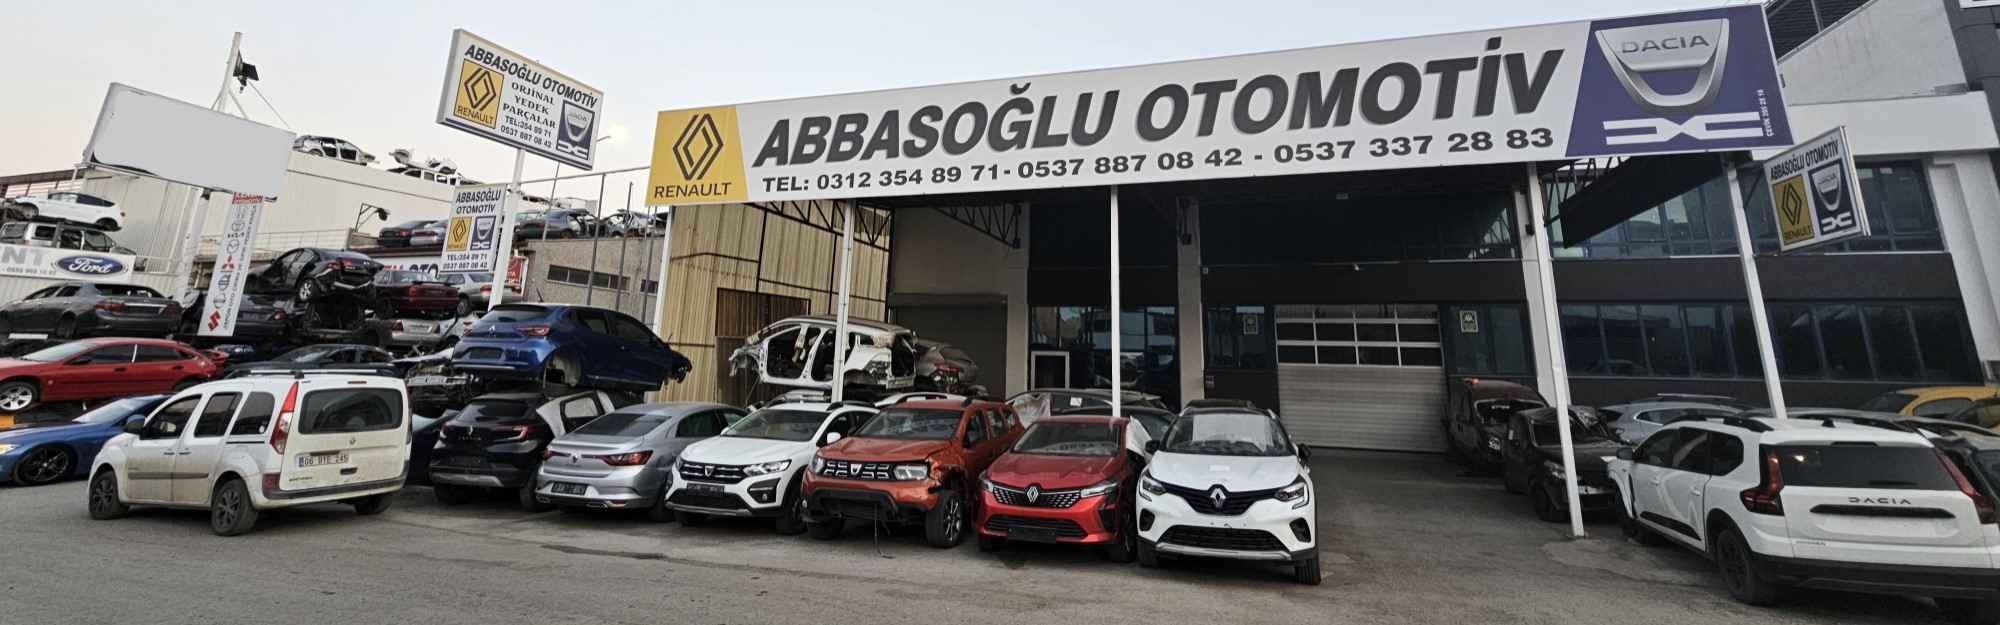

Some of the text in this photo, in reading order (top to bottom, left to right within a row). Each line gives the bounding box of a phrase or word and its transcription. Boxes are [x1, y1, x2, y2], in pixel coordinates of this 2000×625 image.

[1621, 33, 1709, 53] DACIA
[465, 45, 598, 108] ABBASOĞLU OTOMOTİV
[514, 95, 550, 116] YEDEK
[752, 36, 1565, 168] ABBASOĞLU OTOMOTİV
[456, 106, 495, 124] RENAULT
[503, 103, 558, 129] PARÇALAR
[763, 174, 809, 193] TEL:
[817, 171, 872, 191] 0312
[879, 168, 922, 187] 354
[931, 166, 962, 184] 89
[1018, 158, 1084, 178] 0537
[1095, 154, 1145, 174] 887
[1157, 151, 1194, 170] 08
[1204, 147, 1242, 168] 42
[1274, 139, 1356, 163] 0537
[1370, 136, 1432, 157] 337
[1448, 131, 1494, 153] 28
[1506, 127, 1554, 149] 83
[1805, 137, 1839, 166] OTOMOTİV
[456, 188, 501, 203] ABBASOĞLU
[655, 181, 731, 199] RENAULT
[456, 204, 496, 214] OTOMOTİV
[0, 245, 44, 266] NT
[68, 257, 112, 273] Ford
[1848, 496, 1912, 505] DACIA
